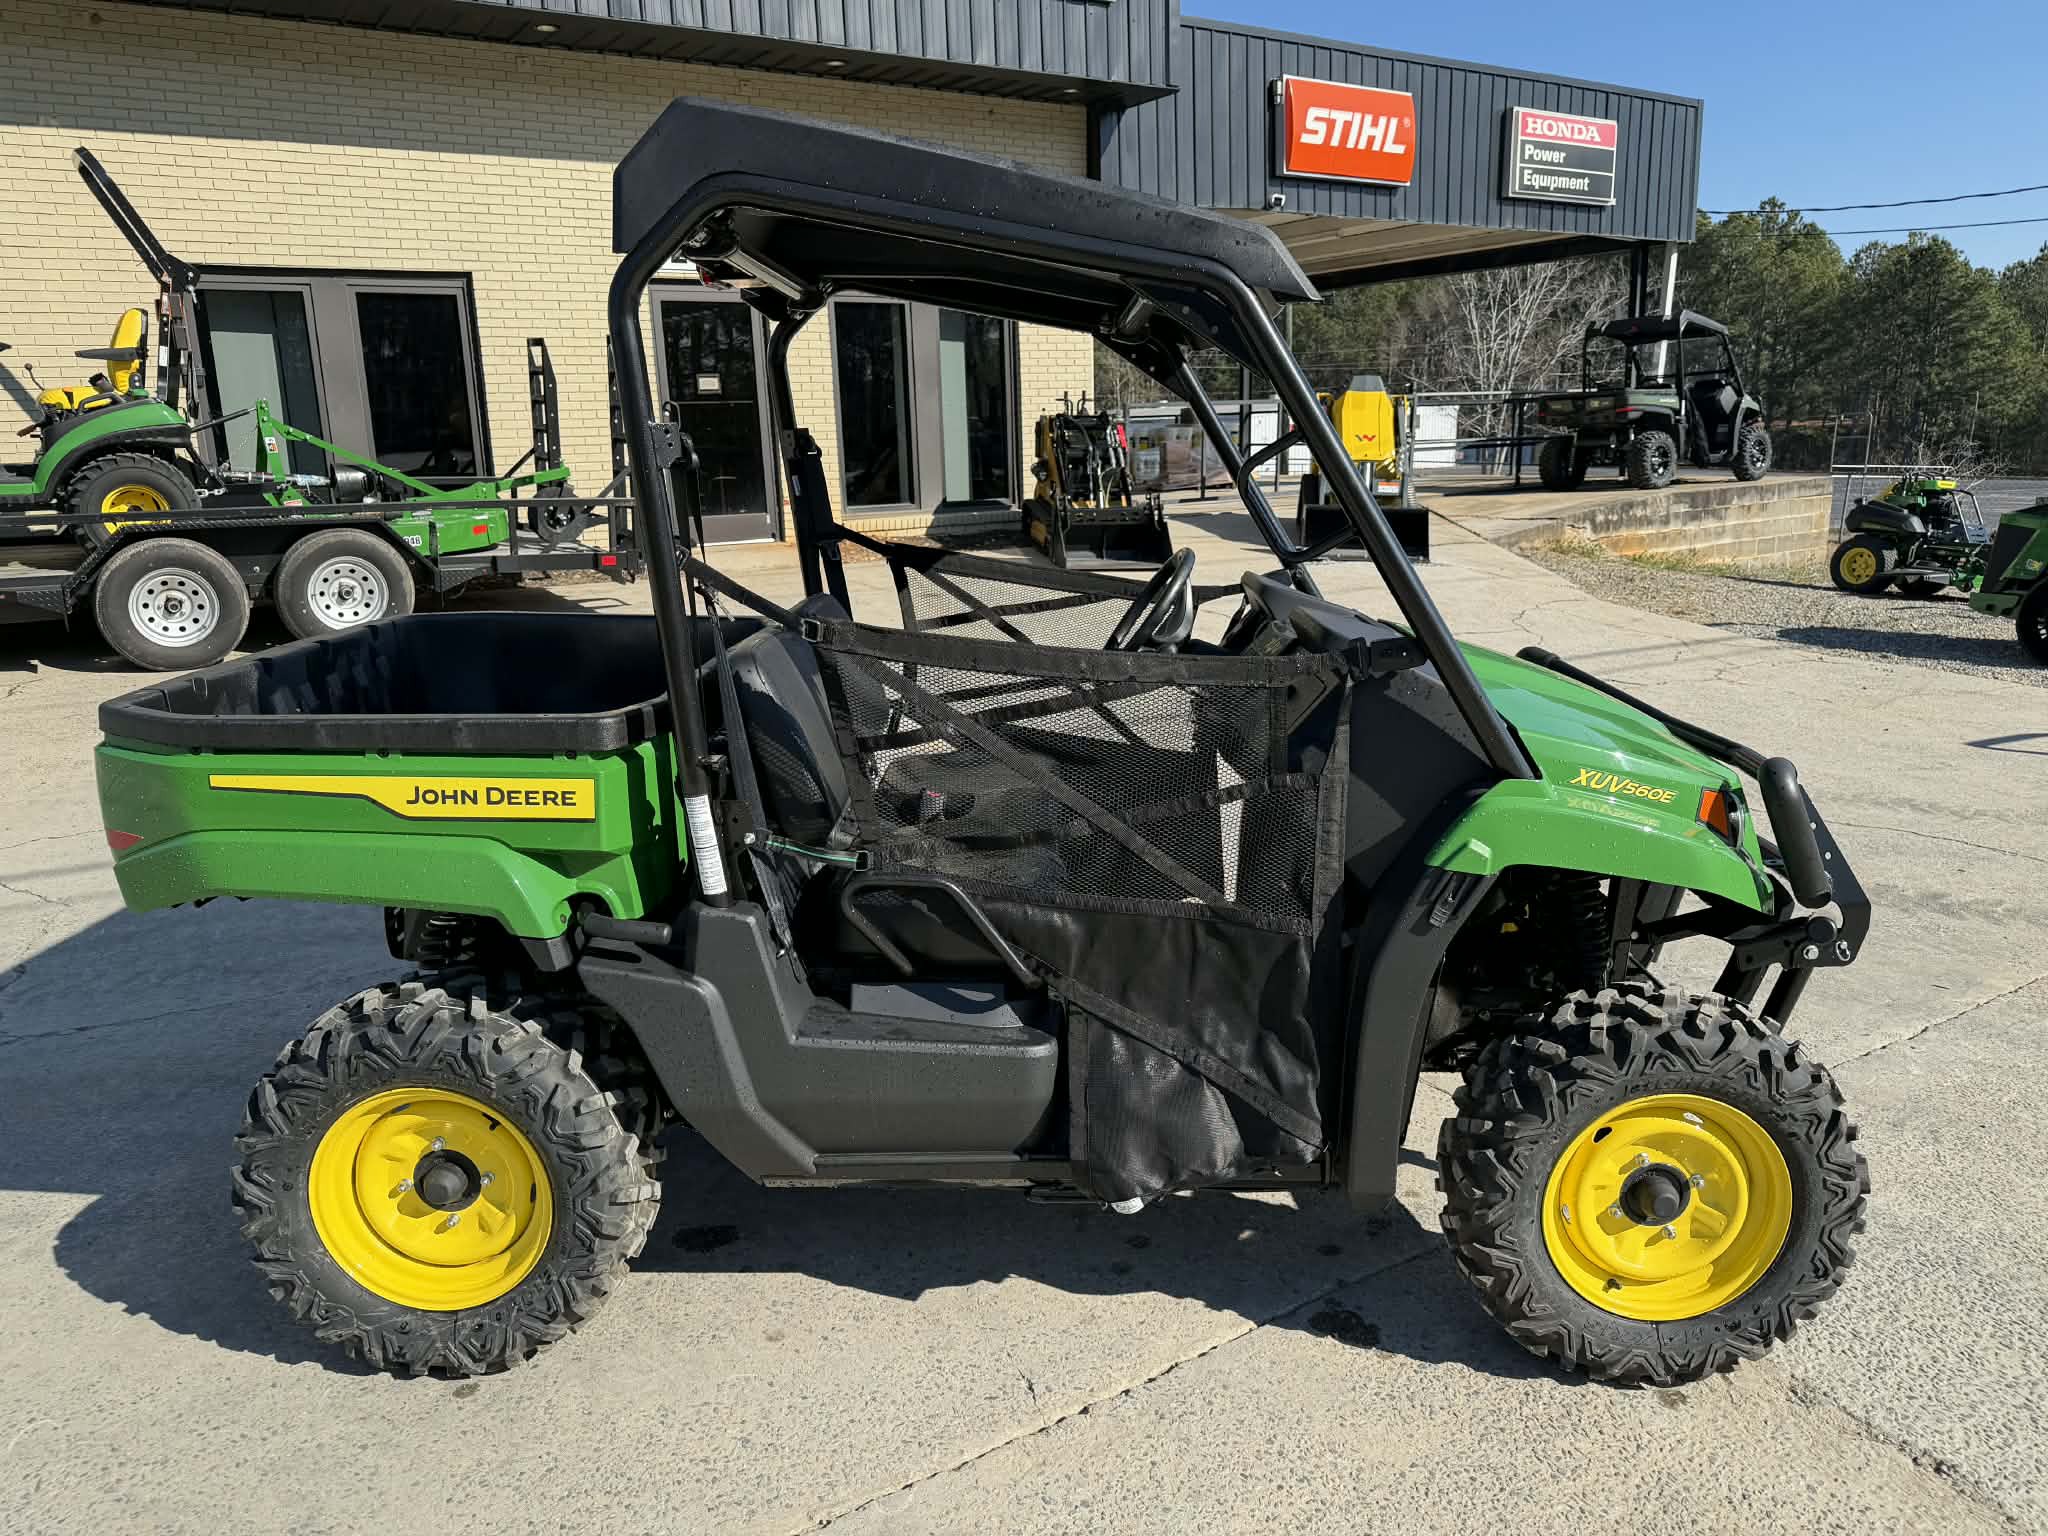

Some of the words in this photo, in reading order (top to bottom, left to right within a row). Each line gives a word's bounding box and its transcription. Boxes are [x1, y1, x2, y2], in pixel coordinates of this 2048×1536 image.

[1300, 106, 1406, 154] STIHL
[1526, 117, 1601, 142] HONDA
[1524, 143, 1566, 163] Power
[1523, 169, 1590, 191] Equipment
[406, 786, 477, 805] JOHN
[485, 787, 577, 806] DEERE
[1569, 768, 1677, 803] XUV560E
